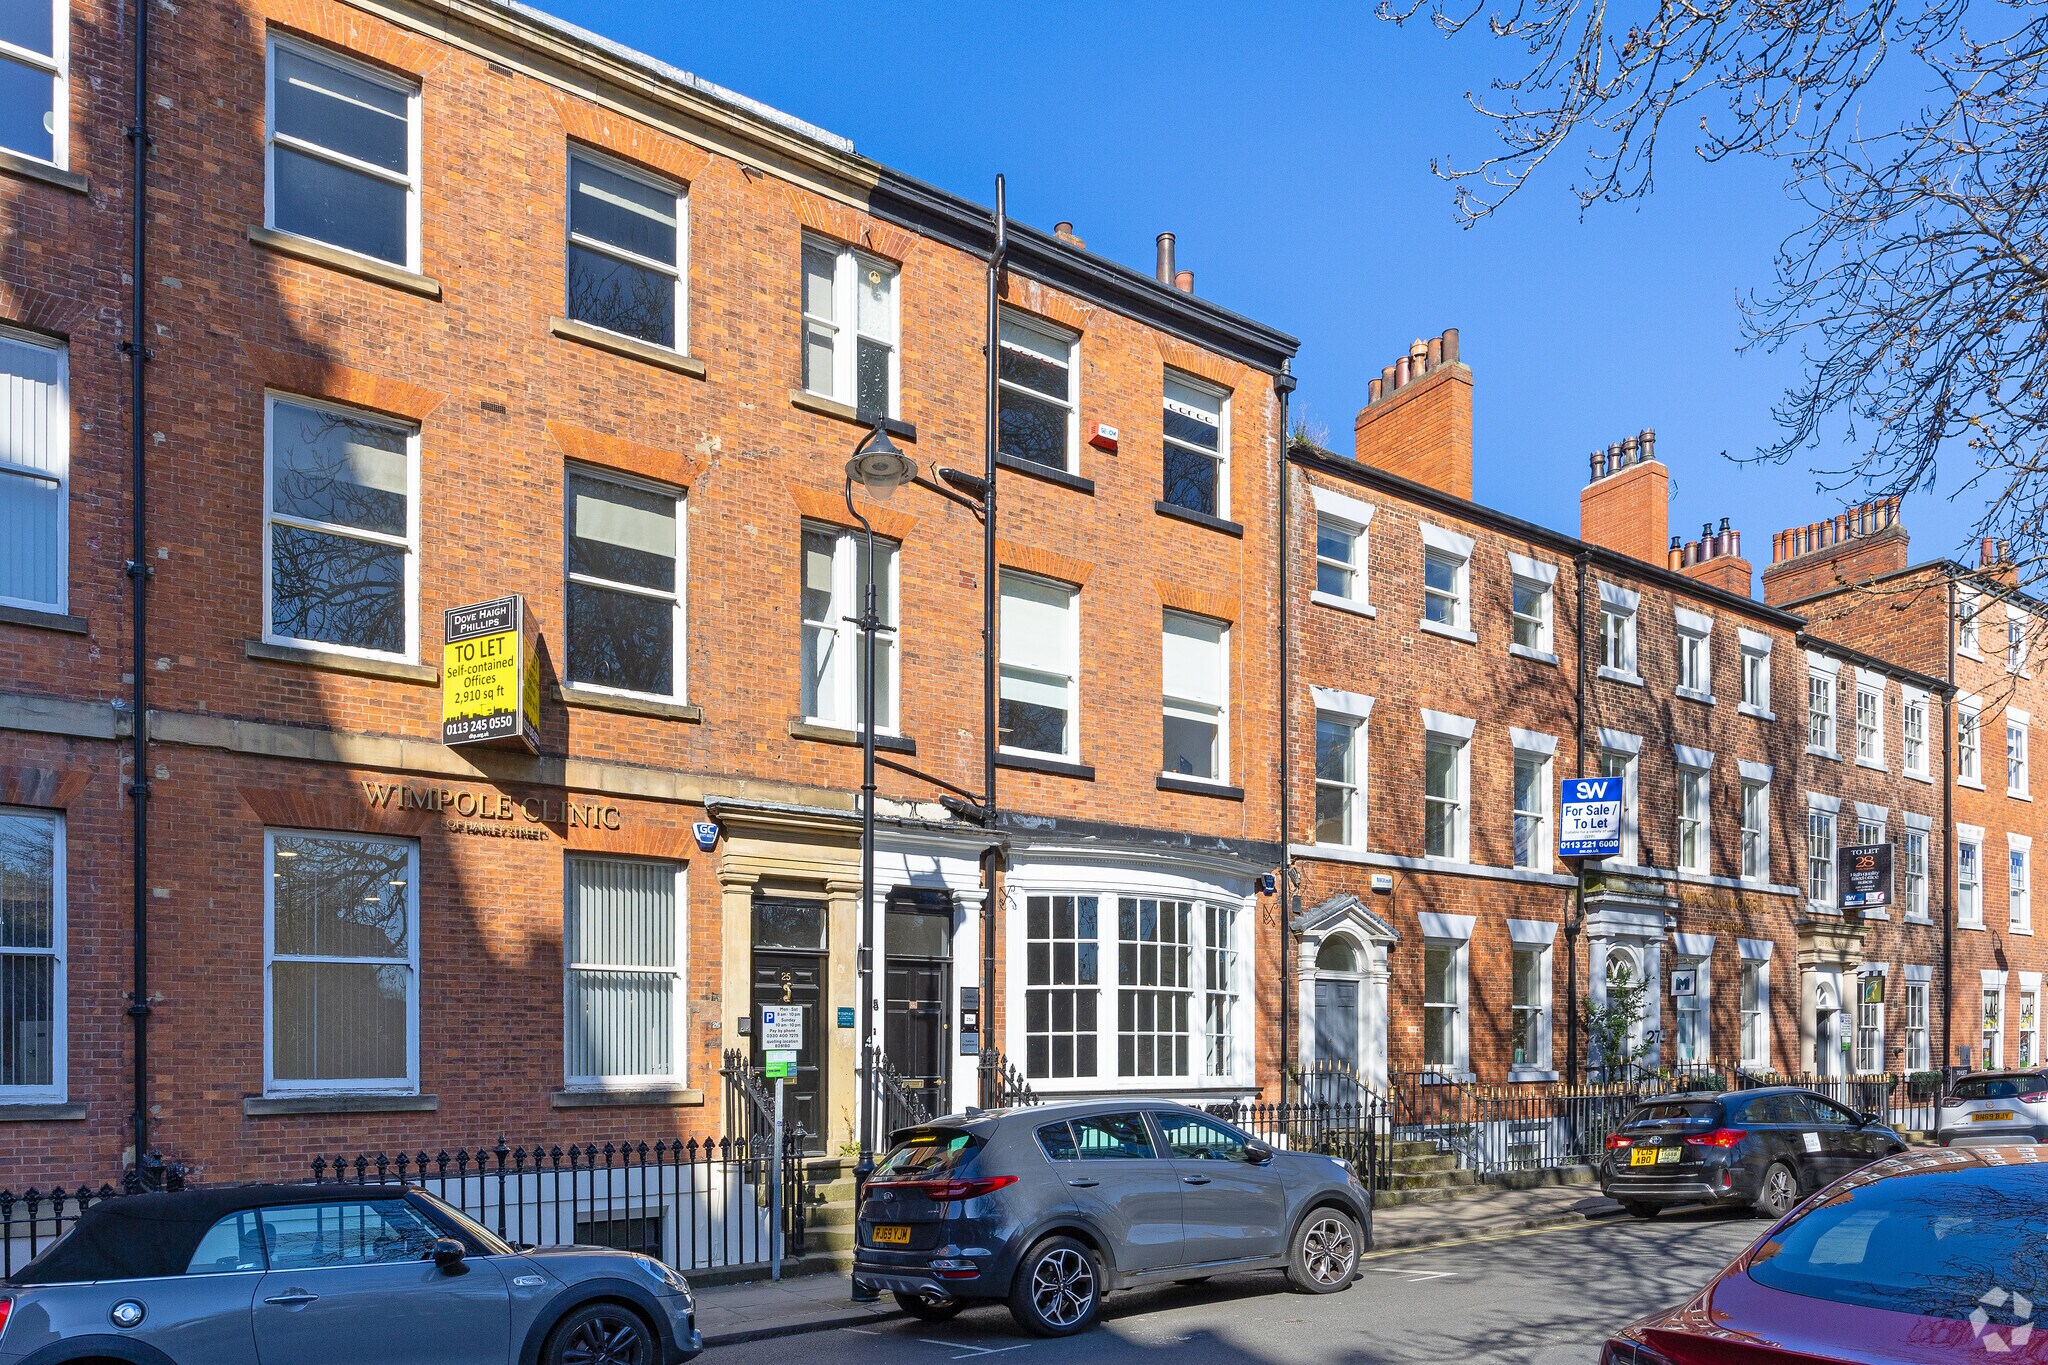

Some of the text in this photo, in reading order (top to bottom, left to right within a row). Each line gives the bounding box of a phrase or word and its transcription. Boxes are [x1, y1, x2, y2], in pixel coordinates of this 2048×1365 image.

[454, 606, 507, 625] DOVE HAIGH
[460, 618, 500, 634] PHILLIPS
[455, 636, 506, 662] TO LET
[447, 655, 514, 678] Self-contained
[464, 674, 496, 688] Offices
[454, 684, 504, 704] 2,910 sq ft
[446, 714, 513, 736] 0113 245 0550
[1576, 782, 1608, 800] SW
[360, 780, 621, 830] WIMPOLE CLINIC
[1566, 804, 1617, 816] For Sale /
[446, 819, 544, 836] OF HARLEY STREET
[700, 824, 714, 834] GC
[1574, 818, 1608, 829] To Let
[1855, 856, 1875, 868] 28
[781, 972, 790, 981] 25
[1676, 976, 1690, 990] M
[766, 1013, 773, 1022] P
[1646, 1030, 1660, 1044] 27
[876, 1228, 892, 1240] RJ69
